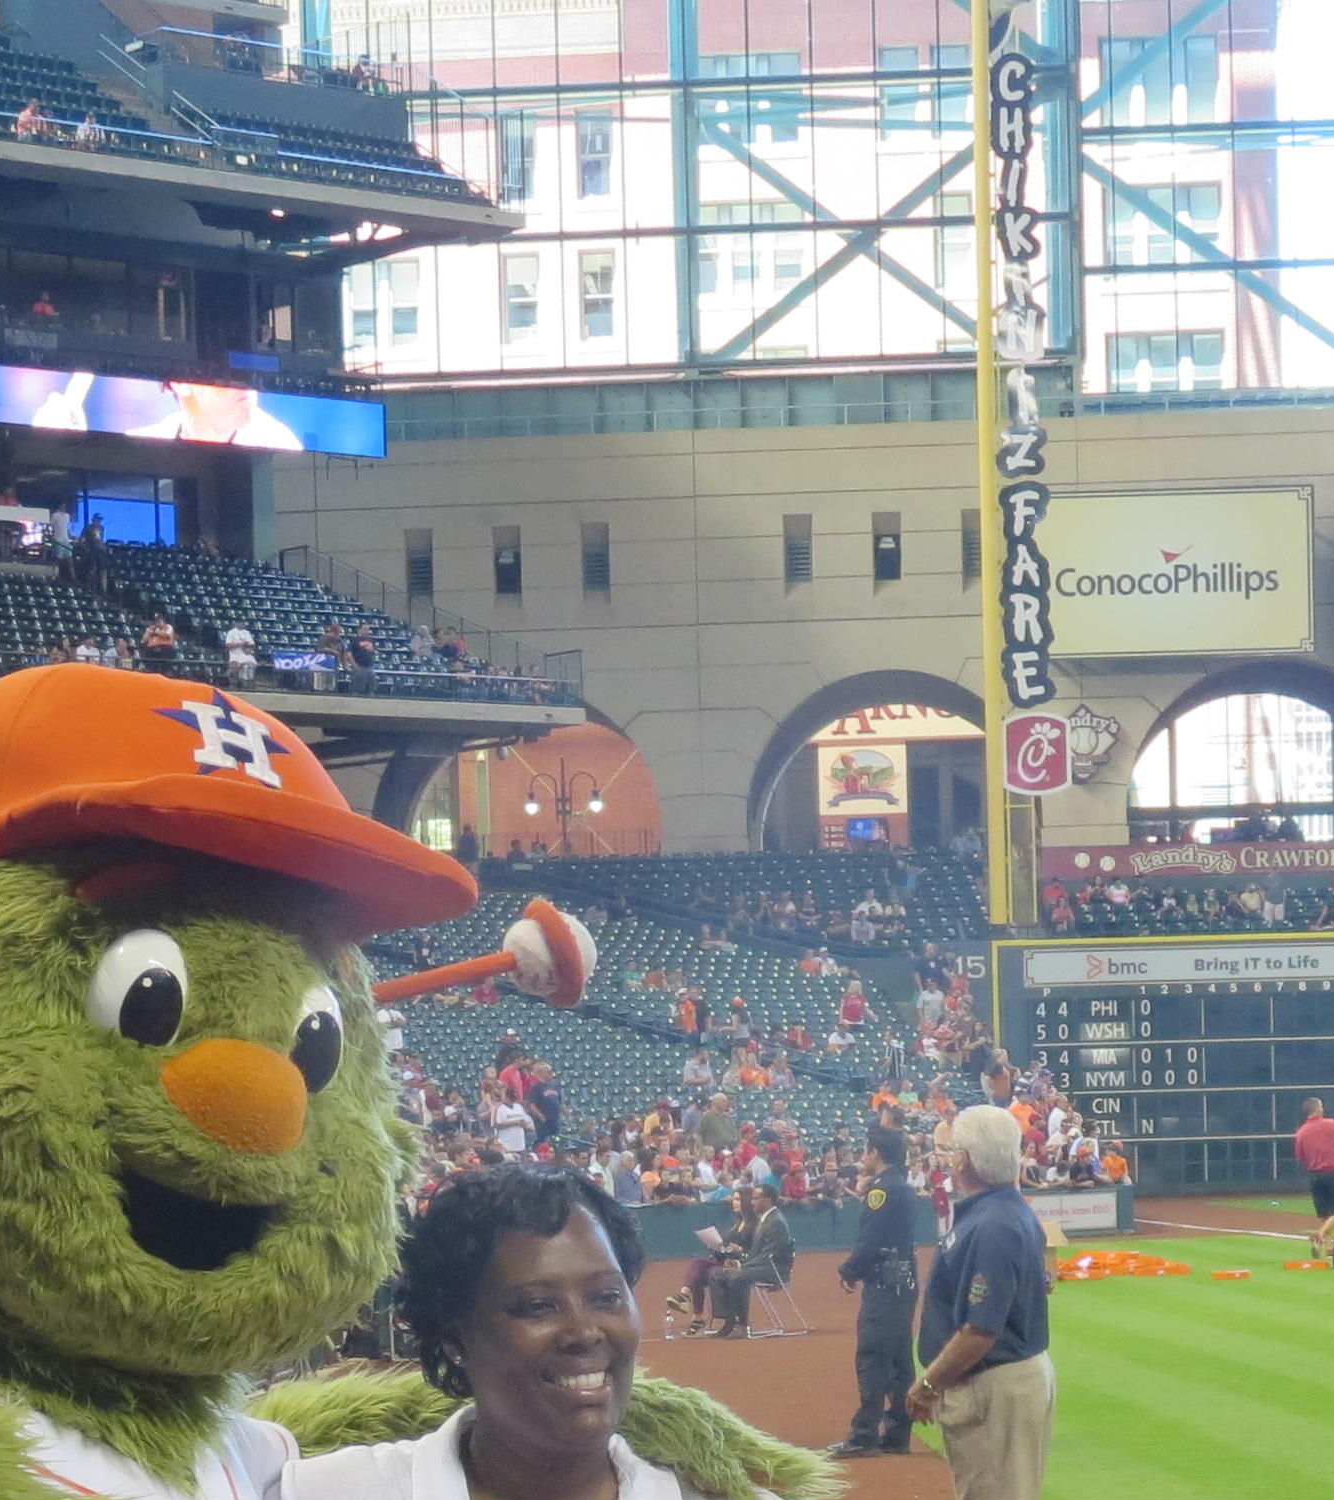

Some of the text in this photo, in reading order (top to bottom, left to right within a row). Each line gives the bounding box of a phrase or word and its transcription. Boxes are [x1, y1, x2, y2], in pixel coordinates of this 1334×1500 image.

[1055, 563, 1279, 600] ConocoPhillips
[1009, 490, 1046, 700] FARE
[181, 700, 283, 790] H
[1130, 844, 1237, 874] Landry's
[1108, 957, 1148, 975] bmc
[1194, 955, 1320, 974] Bring IT to Life
[1036, 1003, 1046, 1018] 4
[1058, 1002, 1068, 1017] 4
[1091, 1001, 1118, 1016] PHI
[1141, 1000, 1151, 1015] 0
[1037, 1025, 1047, 1040] 5
[1058, 1025, 1068, 1039] 0
[1085, 1023, 1125, 1039] WSH
[1141, 1023, 1151, 1037] 0
[1039, 1051, 1048, 1067] 3
[1059, 1051, 1069, 1065] 4
[1092, 1050, 1117, 1064] MIA
[1142, 1049, 1152, 1064] 0
[1166, 1048, 1172, 1063] 1
[1188, 1048, 1198, 1062] 0
[1061, 1073, 1070, 1088] 3
[1086, 1072, 1125, 1088] NYM
[1142, 1071, 1151, 1086] 0
[1165, 1070, 1175, 1085] 0
[1188, 1069, 1198, 1085] 0
[1092, 1099, 1121, 1114] CIN
[1141, 1119, 1154, 1134] N
